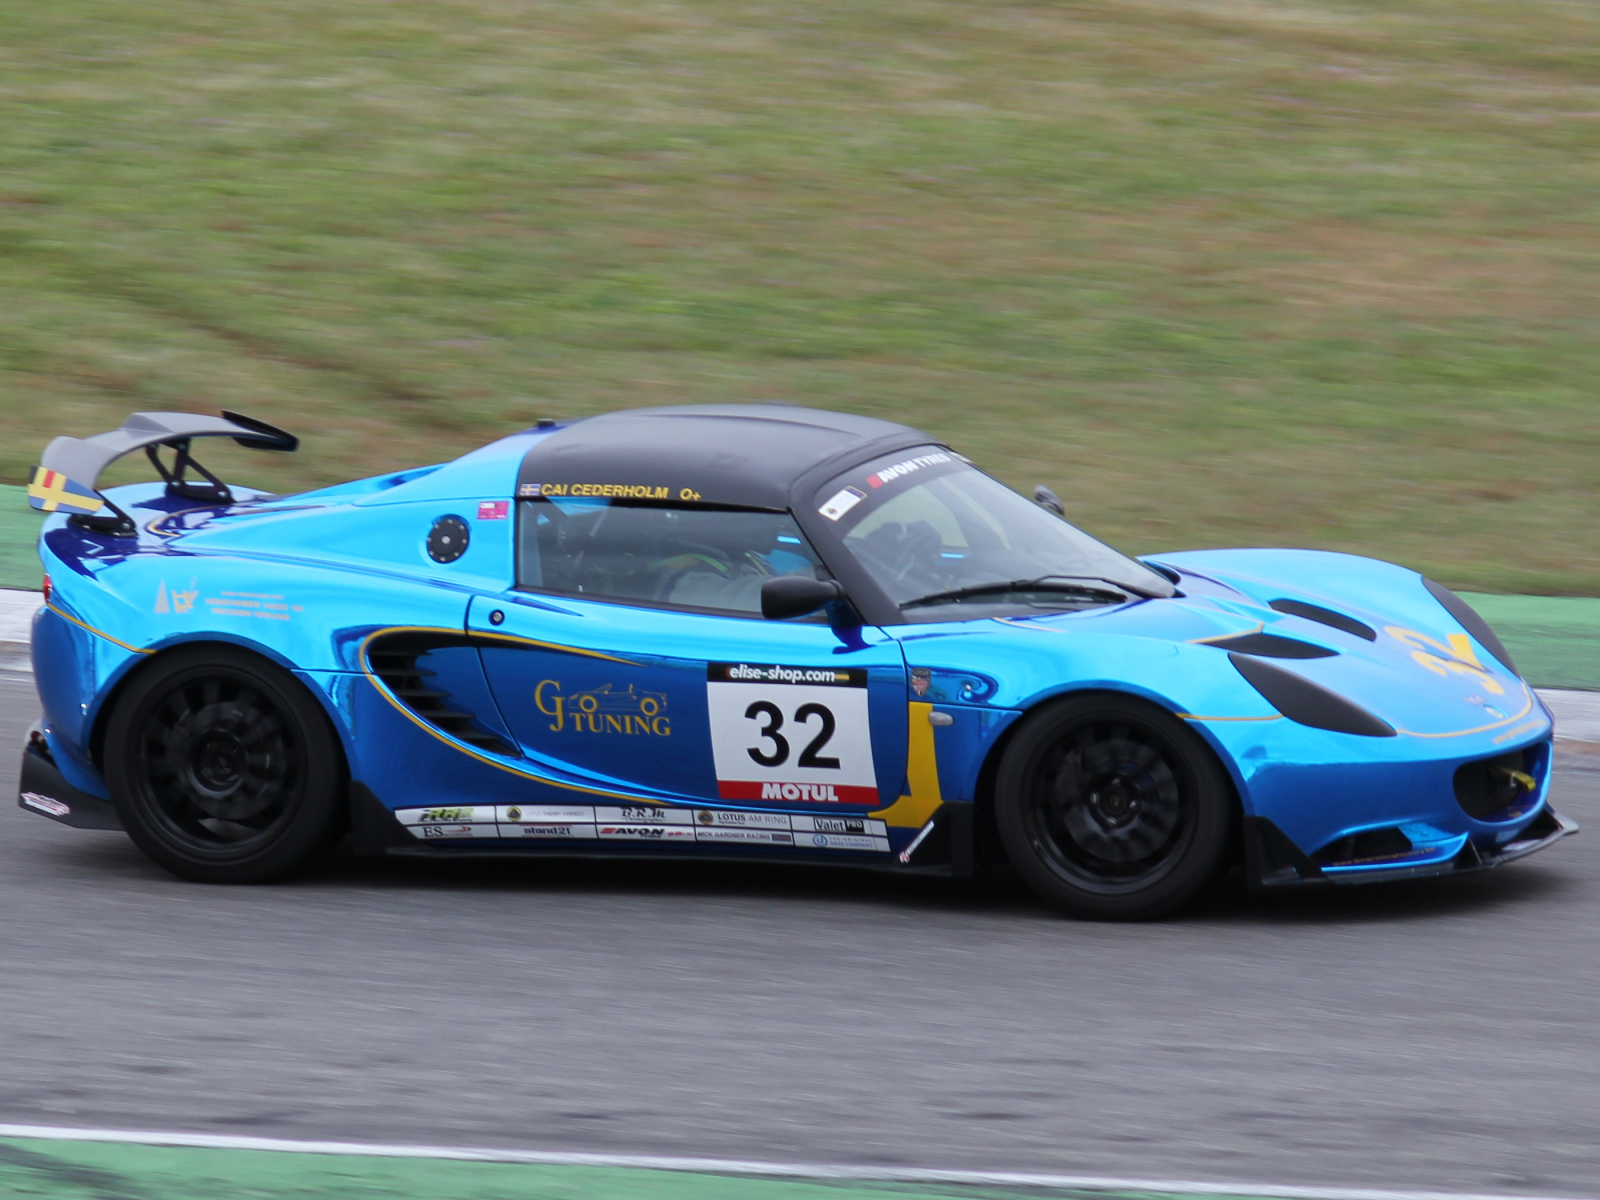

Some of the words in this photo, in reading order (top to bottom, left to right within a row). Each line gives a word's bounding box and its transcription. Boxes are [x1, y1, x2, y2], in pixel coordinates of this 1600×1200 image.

[876, 457, 919, 483] AVON
[912, 452, 952, 468] TYRES
[540, 483, 568, 496] CAI
[571, 483, 669, 499] CEDERHOLM
[729, 664, 835, 684] elise-shop.com
[569, 712, 672, 736] TUNING
[744, 700, 841, 770] 32
[761, 782, 839, 802] MOTUL
[717, 812, 746, 822] LOTUS
[749, 815, 762, 823] AM
[764, 815, 788, 824] RING
[815, 819, 845, 831] Valet
[846, 820, 863, 828] PRO
[422, 826, 444, 838] ES
[523, 827, 571, 836] stand21
[615, 828, 665, 836] AVON
